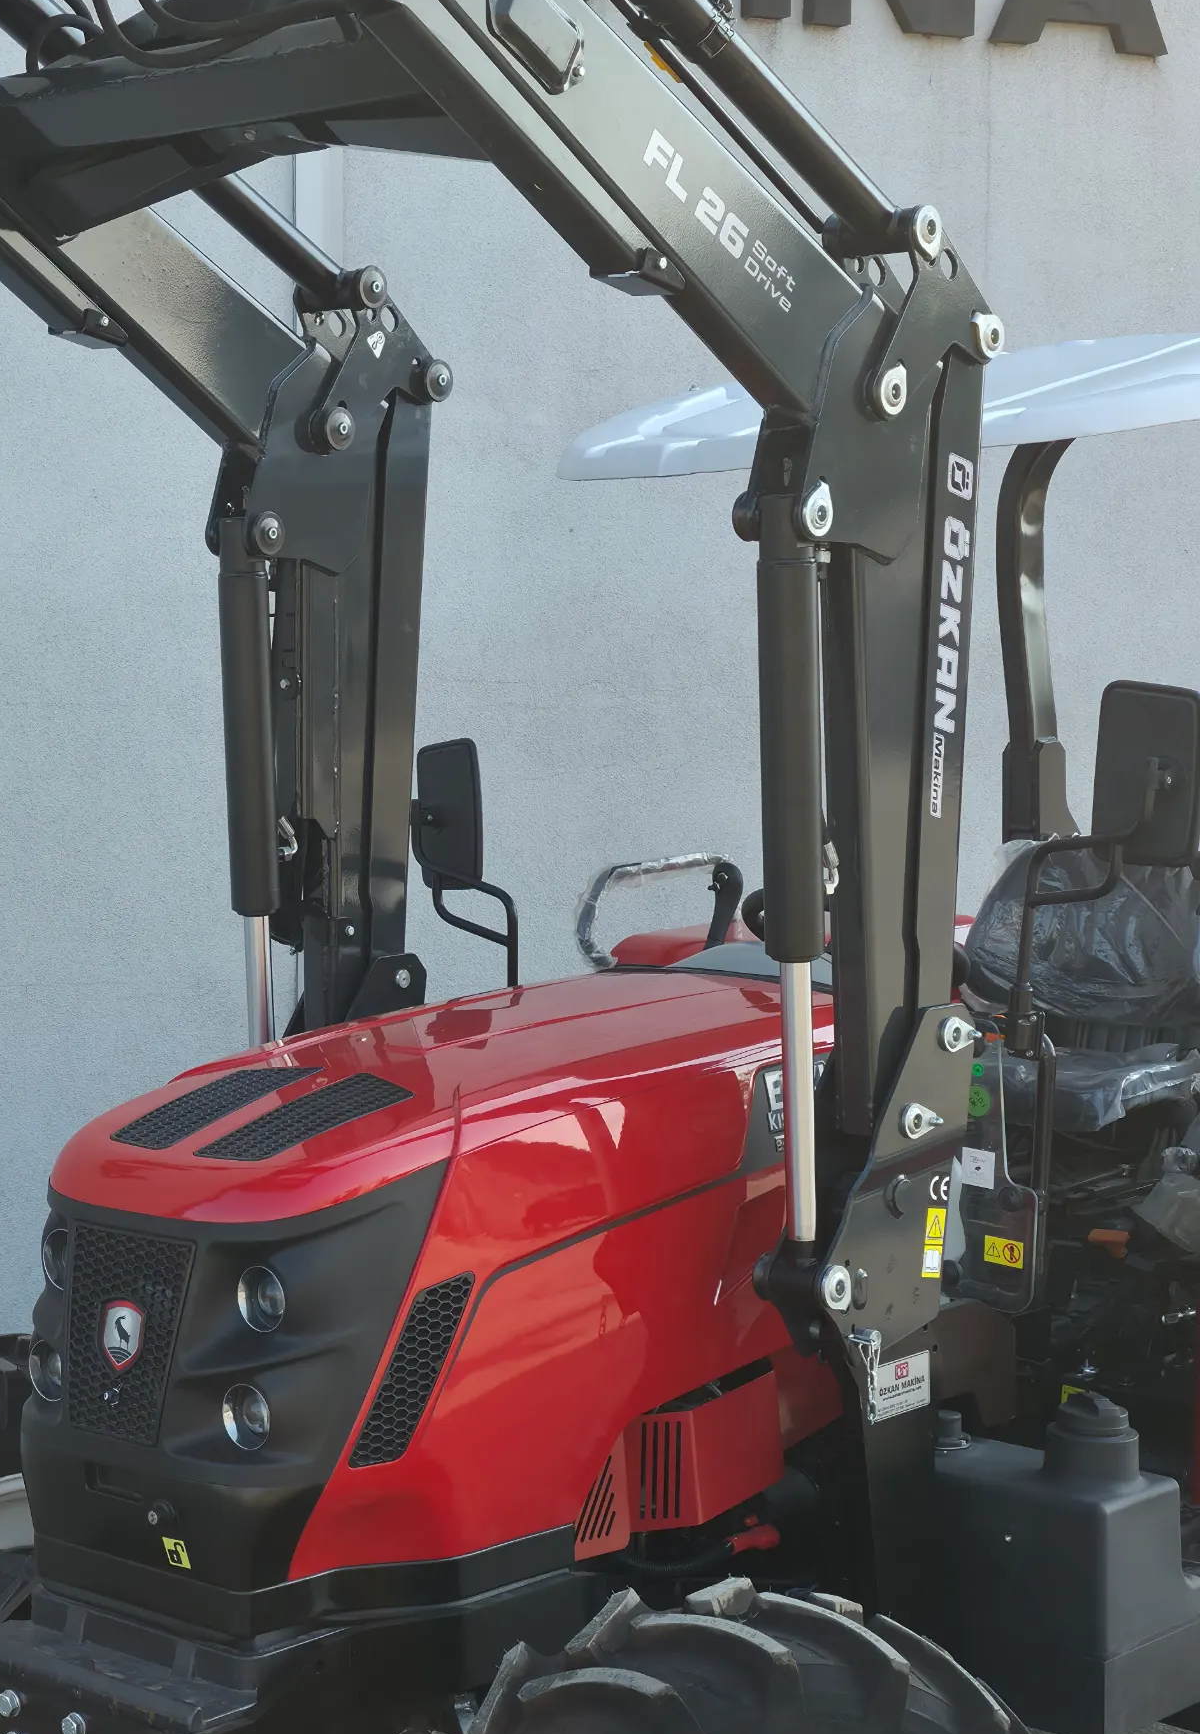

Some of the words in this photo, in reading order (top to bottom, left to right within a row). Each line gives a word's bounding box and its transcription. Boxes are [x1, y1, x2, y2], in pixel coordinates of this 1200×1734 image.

[642, 127, 688, 204] FL
[694, 185, 750, 259] 26
[743, 255, 793, 314] Drive
[751, 239, 797, 294] Soft
[933, 514, 971, 734] ÖZKAN
[930, 735, 945, 816] Makina
[929, 1175, 950, 1201] CE
[879, 1384, 900, 1397] ÖZKAN
[901, 1375, 926, 1390] MAKİNA
